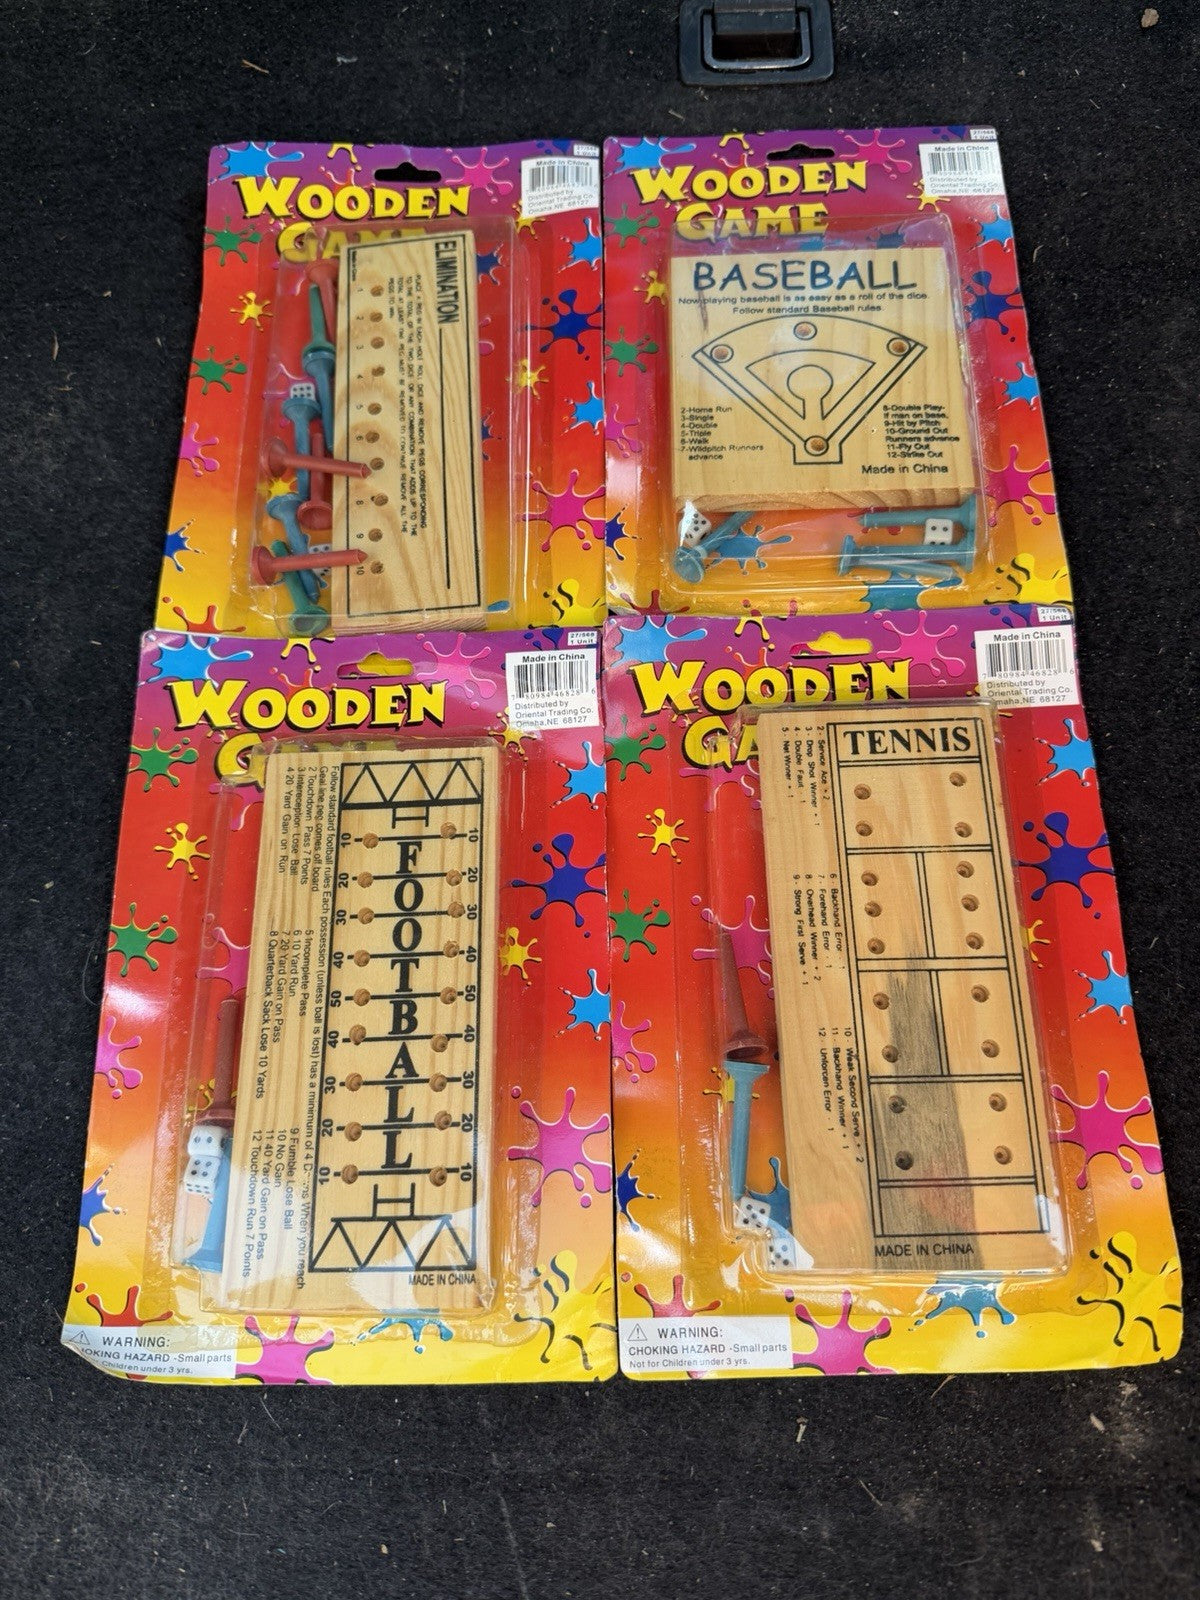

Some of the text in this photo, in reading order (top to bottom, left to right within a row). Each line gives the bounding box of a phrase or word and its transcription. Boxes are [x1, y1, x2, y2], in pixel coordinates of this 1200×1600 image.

[629, 160, 868, 204] WOODEN
[234, 176, 471, 220] WOODEN
[675, 202, 829, 243] GAME
[436, 241, 459, 324] ELIMINATION
[694, 260, 916, 291] BASEBALL
[703, 296, 737, 305] playing
[409, 384, 414, 392] OR
[862, 464, 948, 474] Made in China
[411, 498, 417, 508] UP
[411, 512, 417, 520] TO
[629, 658, 912, 716] WOODEN
[987, 680, 1033, 688] Distributed
[988, 689, 1022, 697] Oriental
[166, 679, 448, 731] WOODEN
[515, 701, 557, 710] Distributed
[843, 726, 971, 755] TENNIS
[306, 775, 317, 820] Touchdown
[304, 826, 312, 847] Pass
[469, 828, 478, 842] 10
[300, 858, 311, 885] Points
[468, 867, 477, 883] 20
[467, 904, 477, 920] 30
[831, 889, 840, 927] Backhand
[293, 940, 301, 950] 10
[466, 945, 476, 962] 40
[265, 940, 278, 996] Quarterback
[290, 953, 300, 974] Yard
[301, 938, 312, 989] Incomplete
[289, 978, 298, 997] Run
[465, 985, 476, 1002] 50
[262, 1001, 272, 1024] Sack
[299, 992, 308, 1016] Pass
[381, 840, 424, 1169] FOOTBALL
[260, 1028, 269, 1051] Lose
[464, 1025, 475, 1042] 40
[844, 1027, 851, 1036] 10
[259, 1055, 268, 1067] 10
[846, 1048, 854, 1071] Weak
[819, 1027, 826, 1037] 12
[824, 1090, 832, 1112] Error
[256, 1071, 266, 1099] Yards
[462, 1071, 474, 1089] 30
[849, 1075, 857, 1108] Second
[461, 1114, 473, 1132] 20
[460, 1163, 472, 1181] 10
[875, 1243, 974, 1256] MADE IN CHINA
[408, 1272, 476, 1286] MADE IN CHINA
[102, 1336, 169, 1347] WARNING:
[657, 1327, 722, 1339] WARNING:
[124, 1353, 169, 1362] HAZARD
[207, 1355, 231, 1363] parts
[629, 1346, 678, 1355] CHOKING
[682, 1344, 725, 1353] HAZARD
[762, 1344, 787, 1353] parts
[102, 1360, 138, 1371] Children
[662, 1359, 697, 1367] Children
